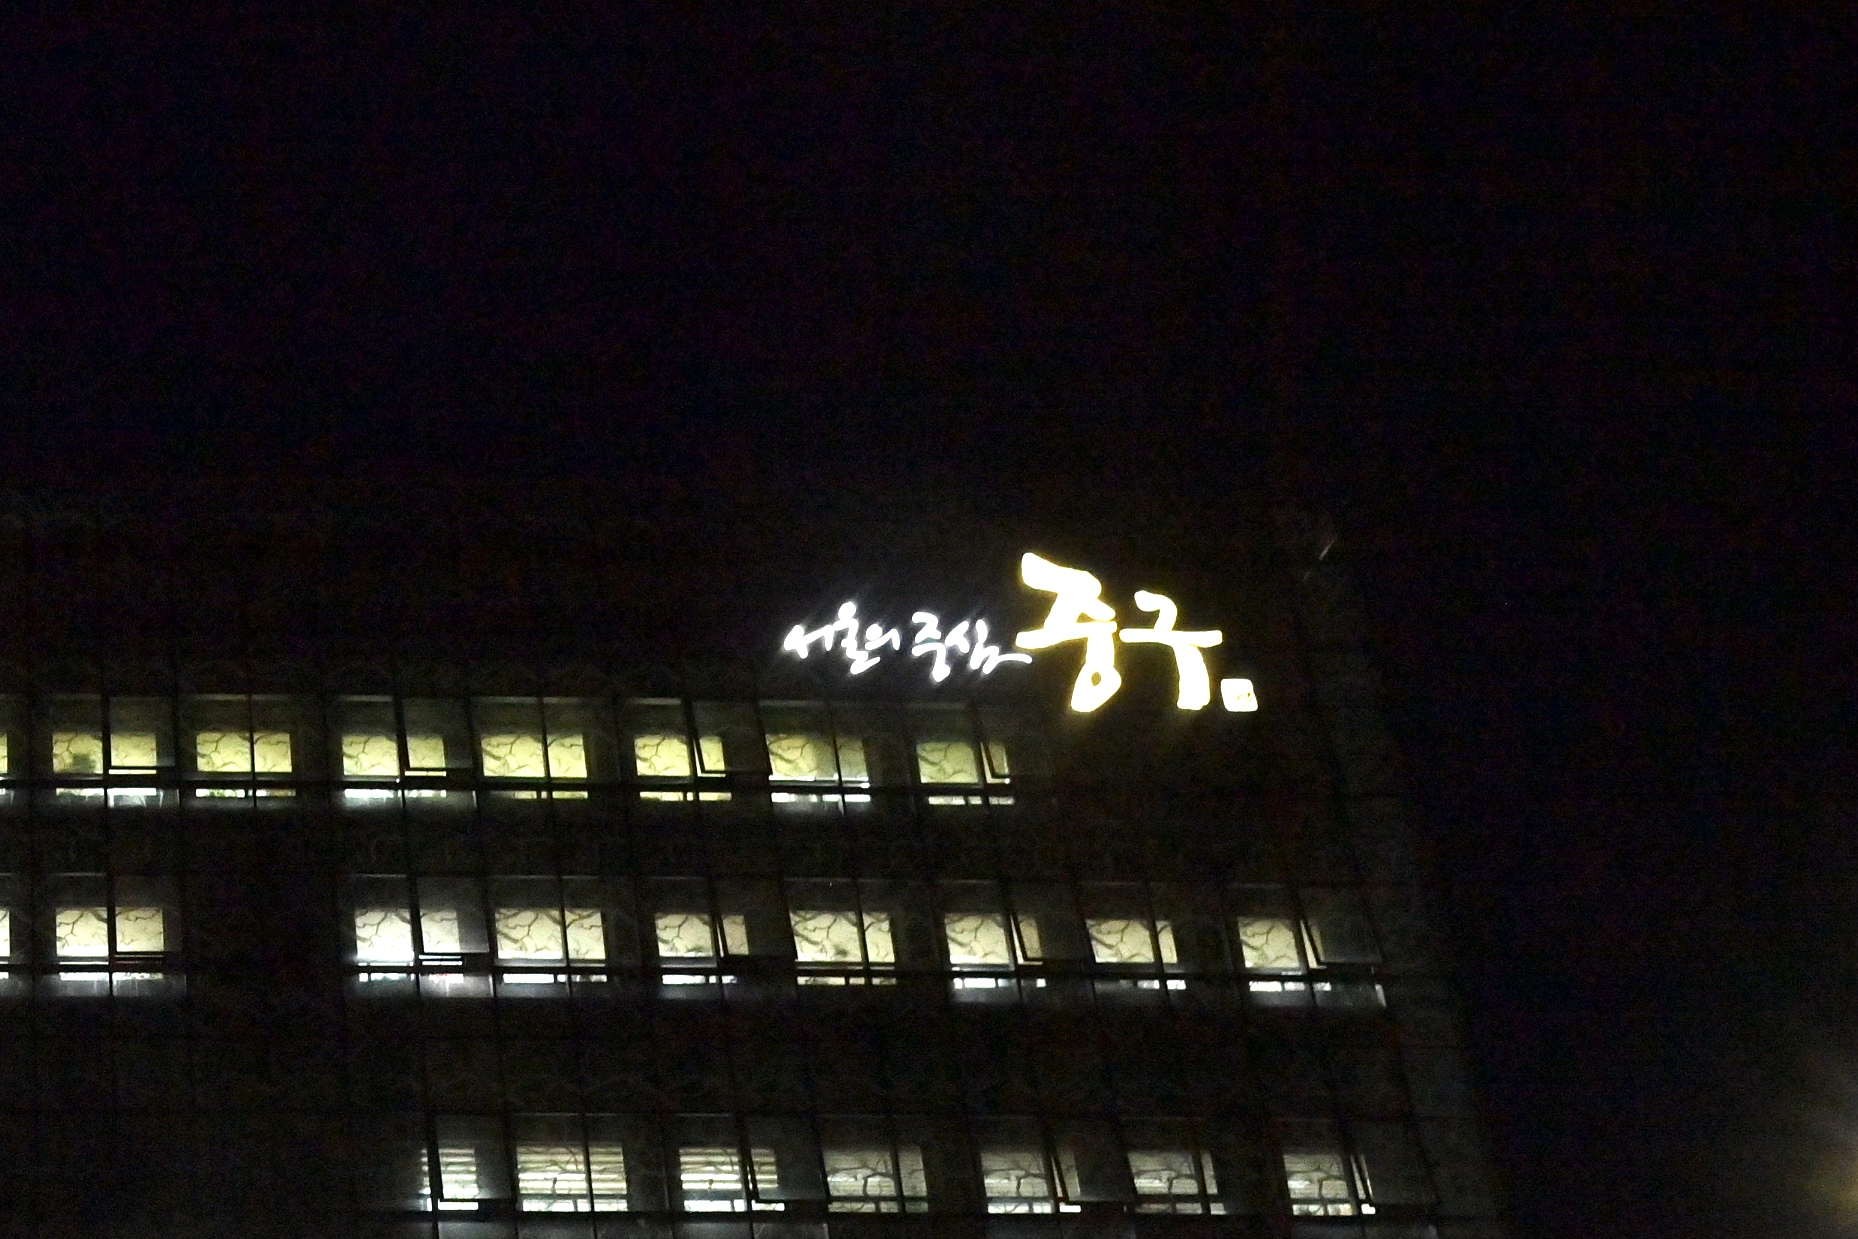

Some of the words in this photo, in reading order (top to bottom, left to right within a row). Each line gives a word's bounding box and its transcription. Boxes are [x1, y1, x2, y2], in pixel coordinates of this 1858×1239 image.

[783, 601, 900, 675] 서울의
[910, 611, 1033, 683] 중심
[1015, 552, 1223, 713] 중구
